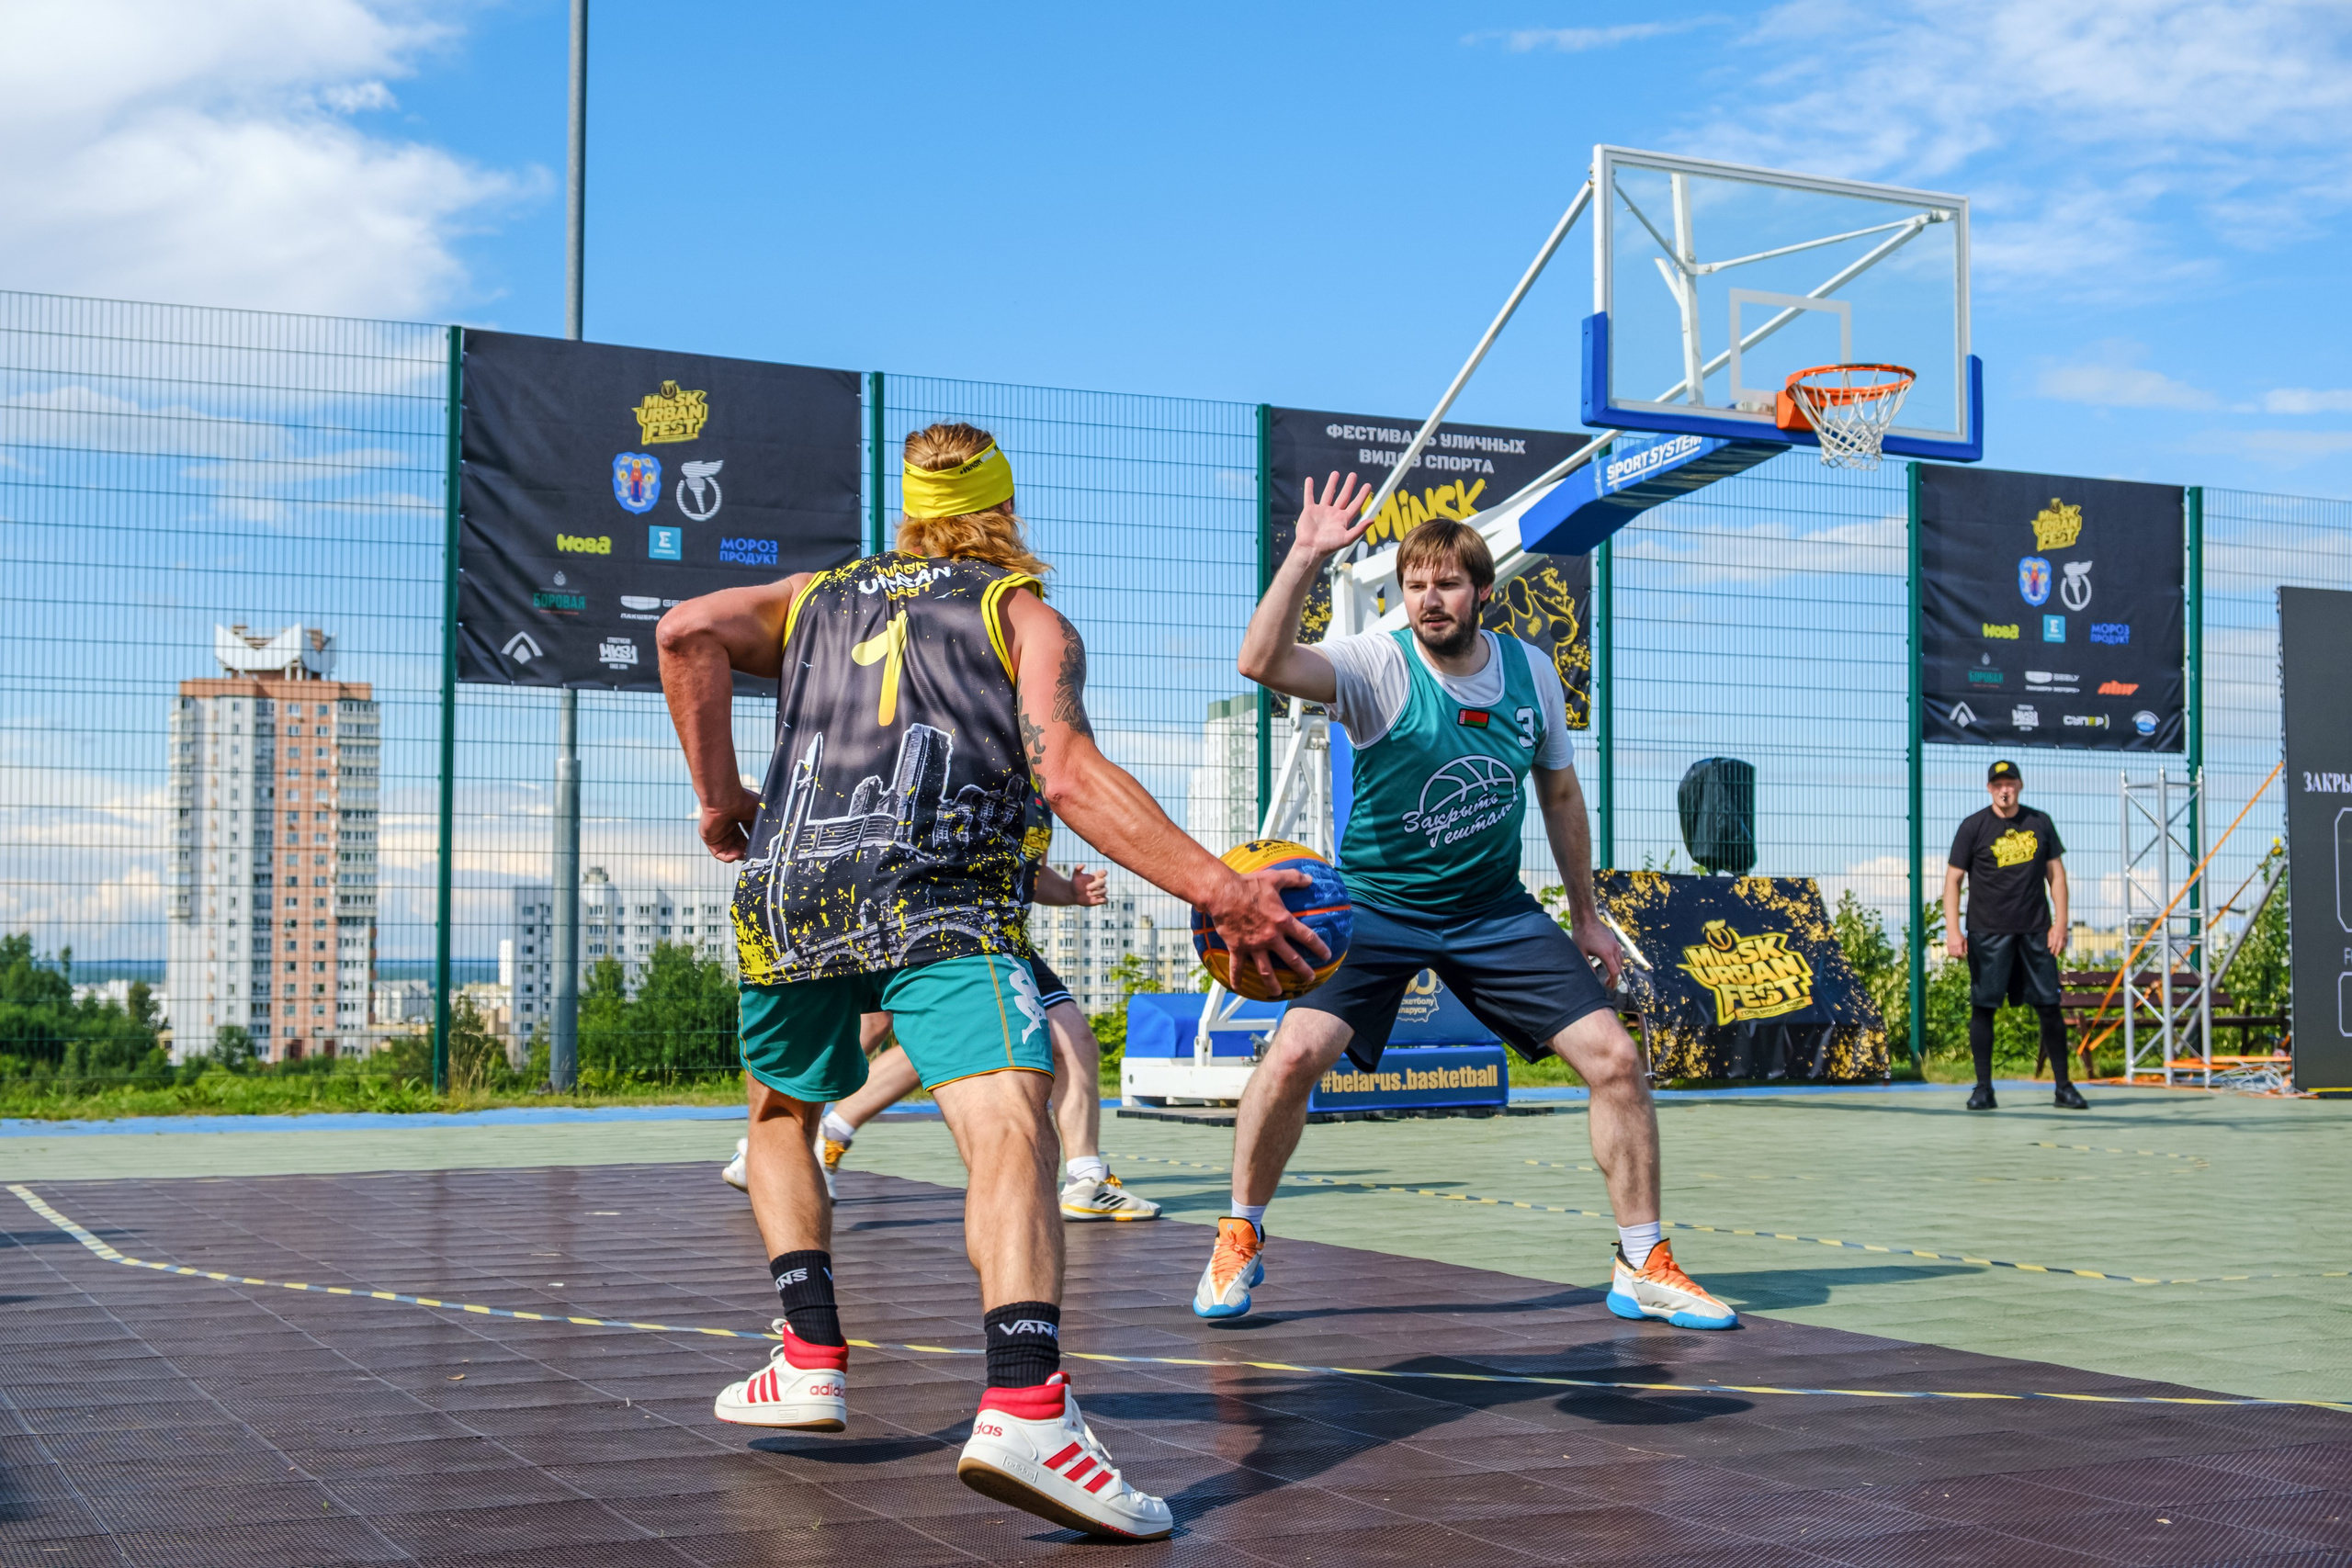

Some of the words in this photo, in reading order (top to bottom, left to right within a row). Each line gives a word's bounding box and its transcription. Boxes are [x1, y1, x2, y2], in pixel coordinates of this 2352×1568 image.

[639, 404, 703, 423] URBAN
[646, 419, 697, 439] FEST
[1326, 423, 1437, 446] ФЕСТИВАЬ
[1440, 433, 1526, 455] УЛИЧНЫХ
[1425, 454, 1495, 474] СПОРТА
[720, 536, 778, 553] МОРОЗ
[719, 551, 777, 566] ПРОДУКТ
[533, 592, 586, 610] БОРОВАЯ
[620, 613, 661, 621] ЛАКШЕРИ
[2090, 623, 2131, 635] МОРОЗ
[2090, 633, 2131, 645] ПРОДУКТ
[852, 609, 910, 727] 1
[1968, 671, 2004, 683] БОРОВАЯ
[1516, 706, 1536, 748] 3
[1401, 792, 1499, 833] Закрыть
[1692, 954, 1802, 986] URBAN
[1717, 976, 1801, 1017] FEST
[1320, 1064, 1498, 1093] #belarus.basketball
